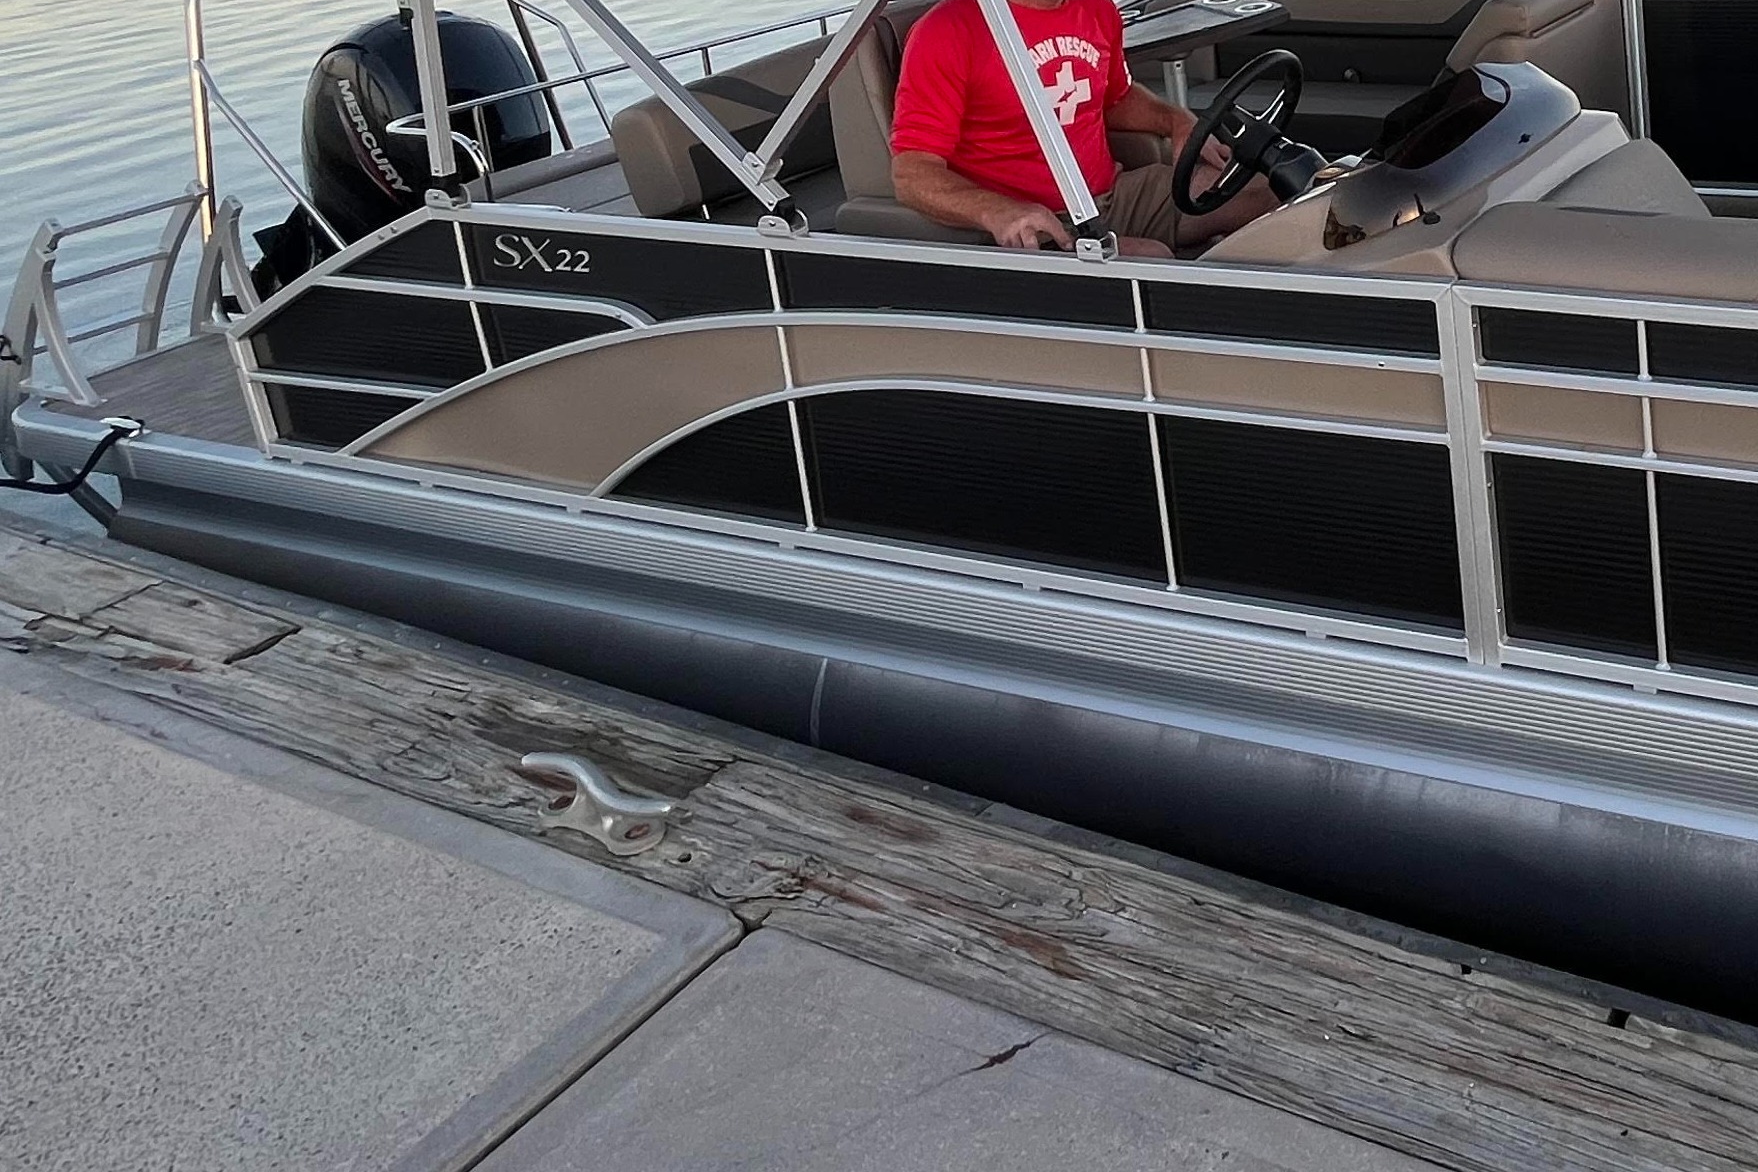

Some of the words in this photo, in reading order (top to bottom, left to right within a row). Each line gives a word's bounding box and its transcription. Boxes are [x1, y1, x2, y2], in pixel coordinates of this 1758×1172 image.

[1027, 38, 1059, 70] ARK
[1055, 35, 1101, 69] RESCUE
[337, 79, 413, 193] MERCURY
